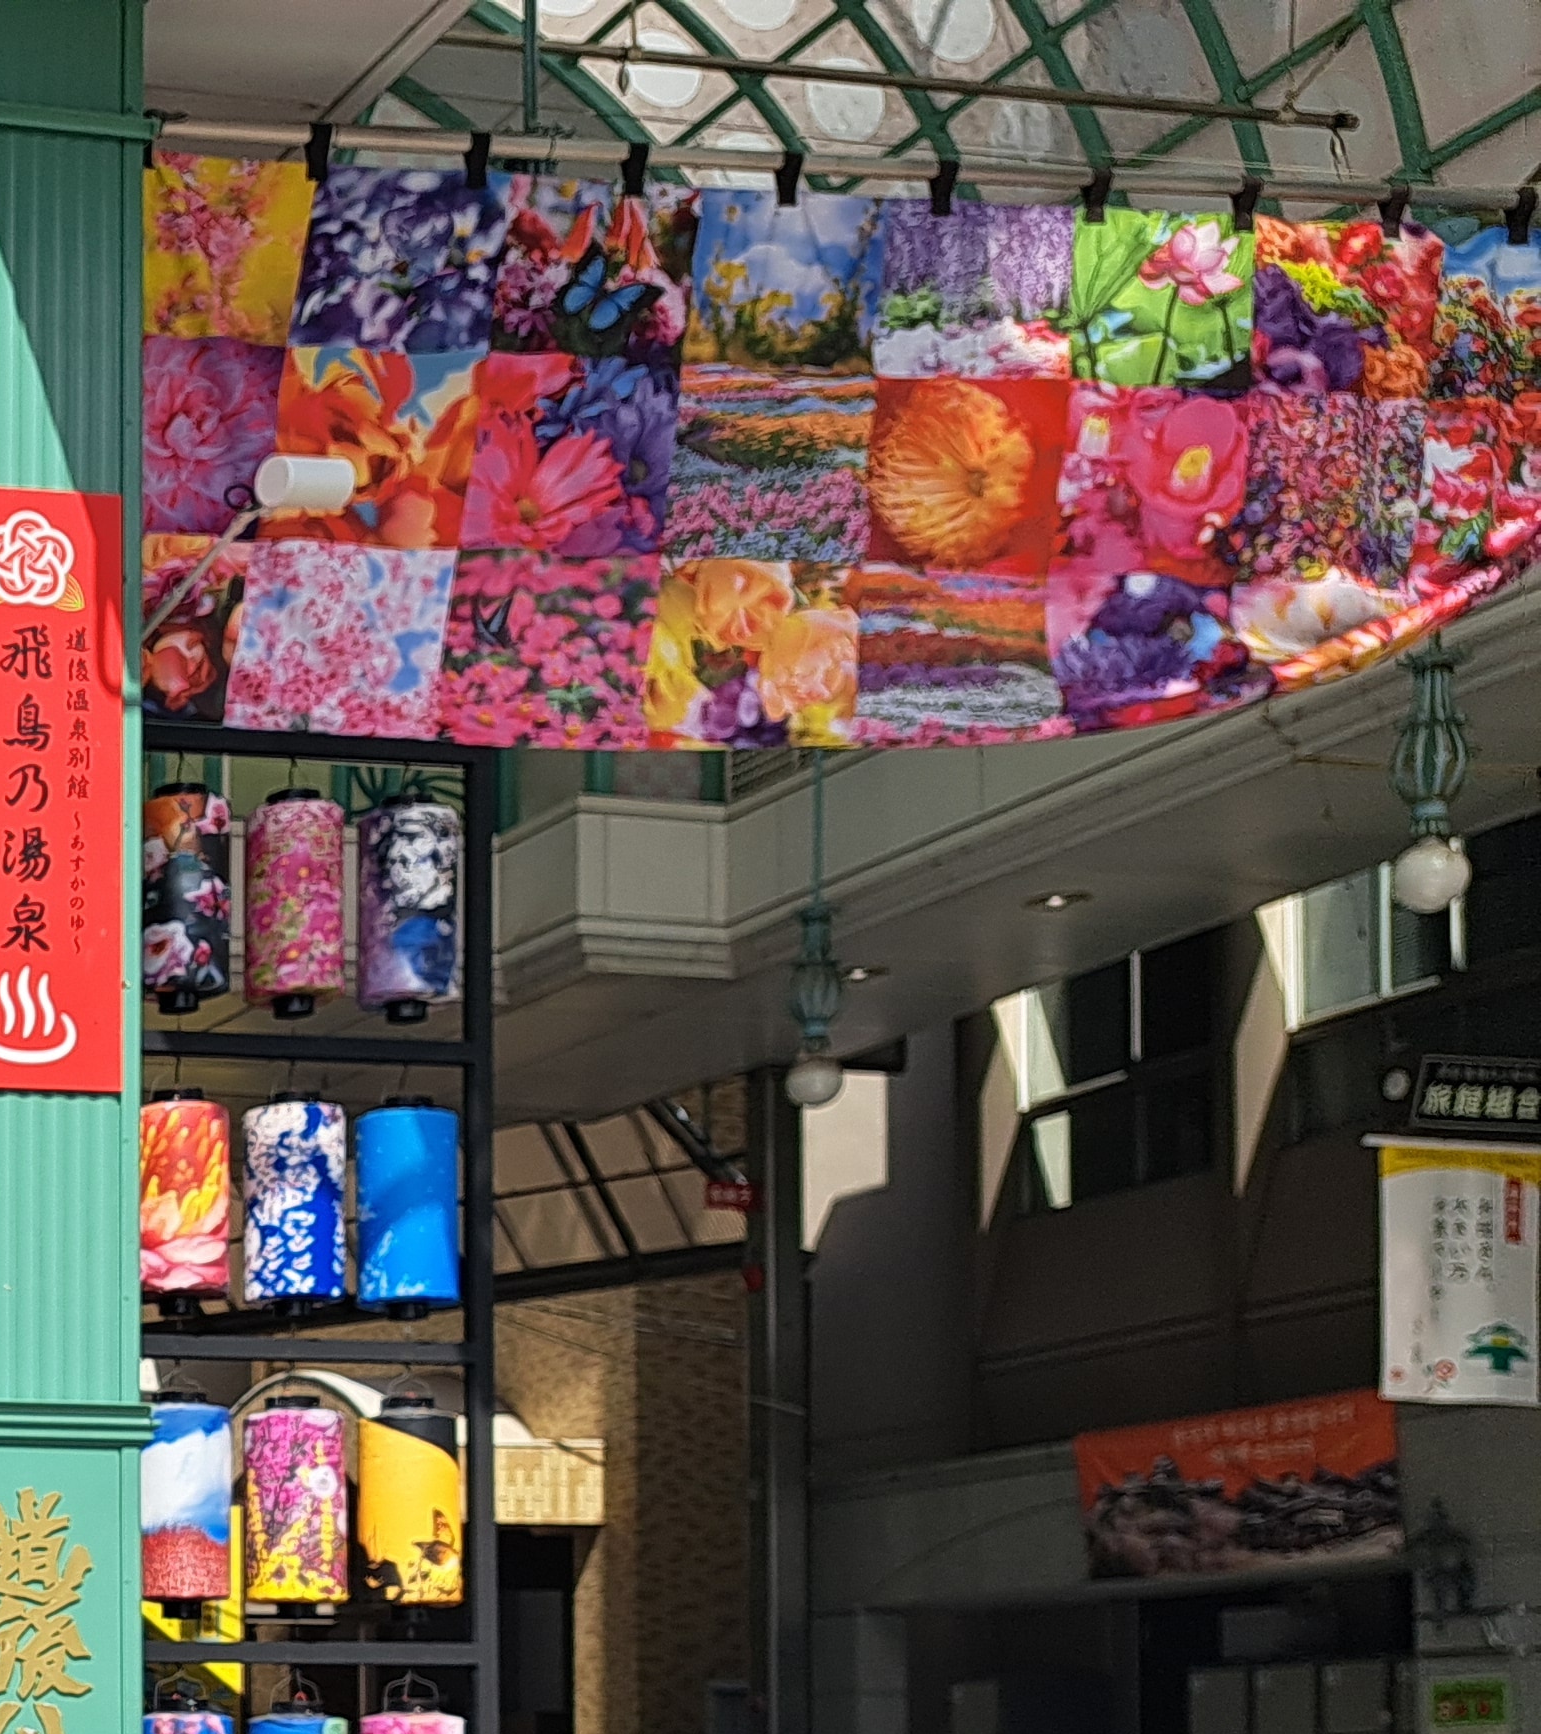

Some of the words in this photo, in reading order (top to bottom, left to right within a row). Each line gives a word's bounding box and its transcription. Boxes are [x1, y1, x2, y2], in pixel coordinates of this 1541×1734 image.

[0, 624, 53, 953] 飛鳥乃湯泉
[66, 627, 90, 800] 道後温泉別館
